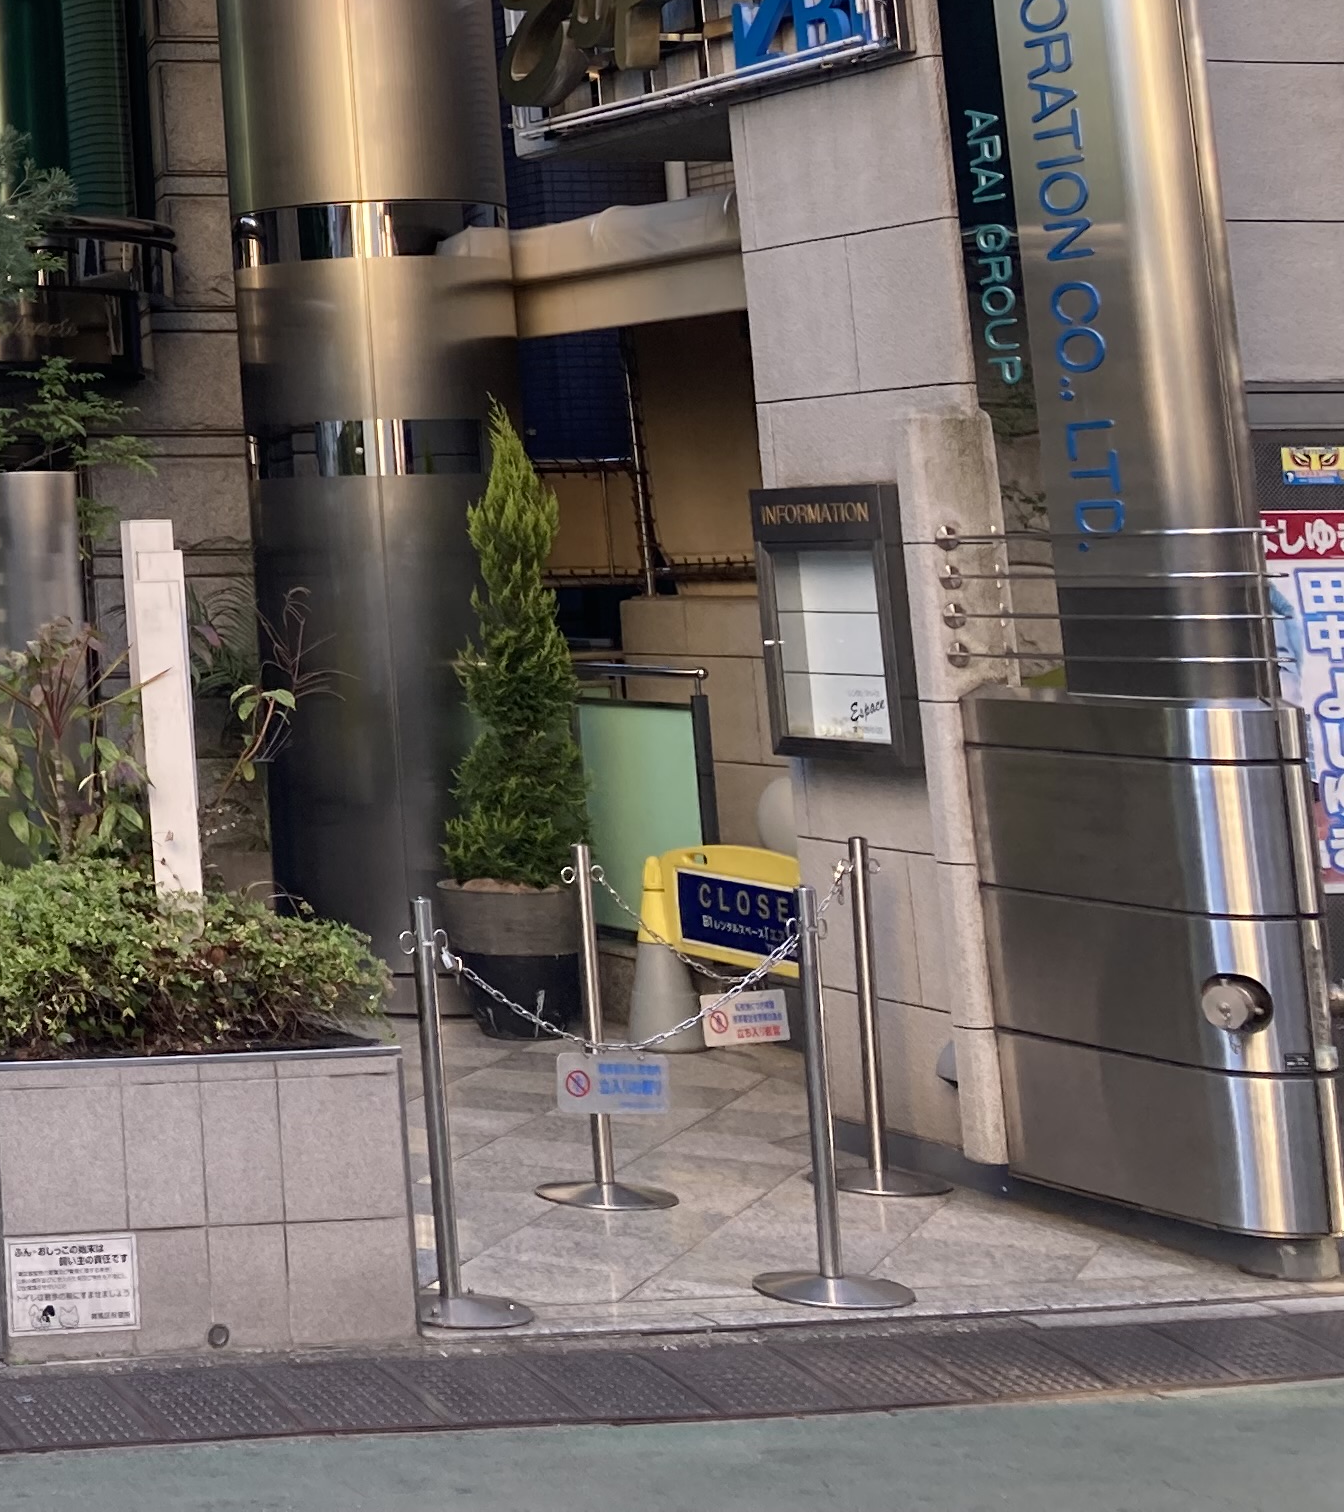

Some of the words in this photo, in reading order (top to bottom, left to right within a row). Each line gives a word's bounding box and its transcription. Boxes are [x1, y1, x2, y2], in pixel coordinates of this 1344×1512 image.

[964, 108, 1007, 204] ARAI
[974, 223, 1023, 385] GROUP
[760, 500, 870, 526] INFORMATION
[1065, 419, 1126, 554] LTD.
[698, 883, 789, 923] CLOSE
